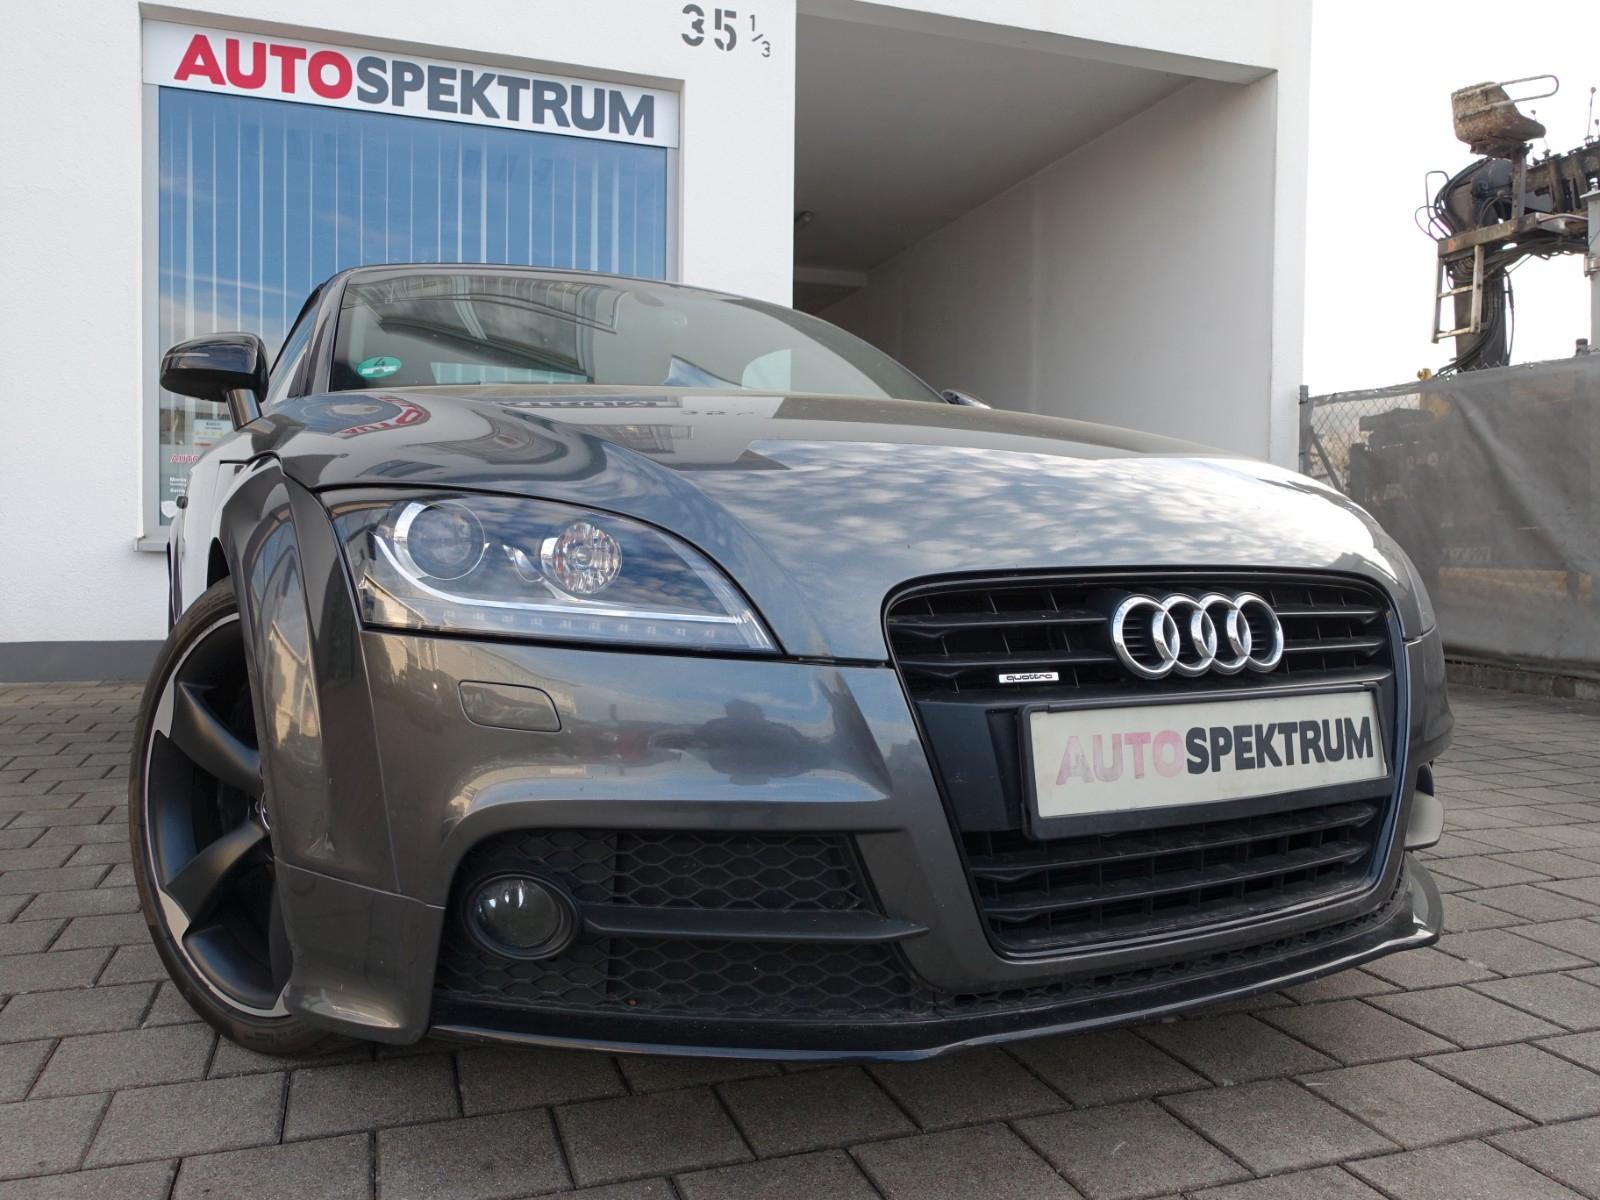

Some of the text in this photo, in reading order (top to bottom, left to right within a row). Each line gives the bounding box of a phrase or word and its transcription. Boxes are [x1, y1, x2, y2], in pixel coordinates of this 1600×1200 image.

[681, 4, 737, 52] 35
[174, 34, 655, 139] AUTOSPEKTRUM
[1006, 673, 1053, 683] quattro
[1056, 716, 1374, 785] AUTOSPEKTRUM
